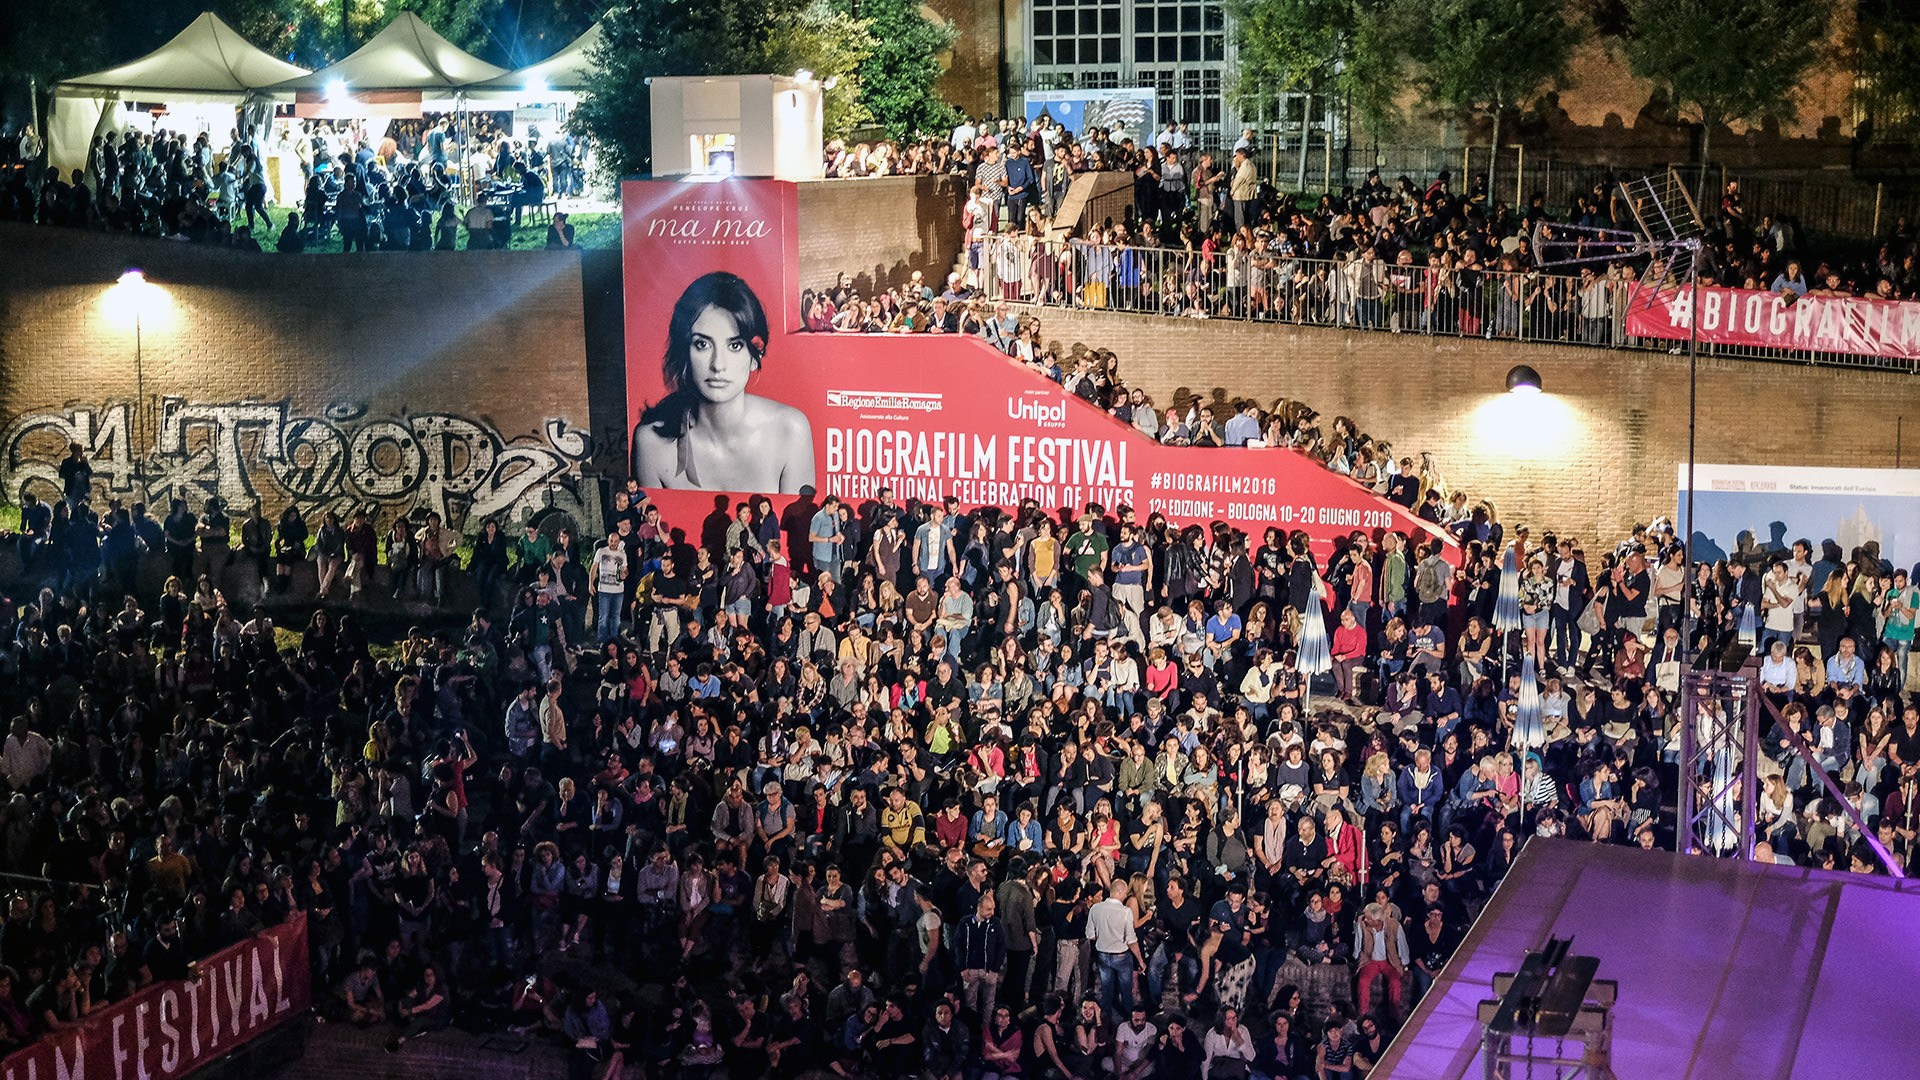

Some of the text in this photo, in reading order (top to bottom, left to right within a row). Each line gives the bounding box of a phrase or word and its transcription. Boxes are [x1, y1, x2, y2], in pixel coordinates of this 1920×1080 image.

[647, 218, 772, 238] ma ma
[1008, 396, 1066, 428] Unipol
[826, 428, 1134, 488] BIOGRAFILM FESTIVAL
[952, 480, 1056, 509] CELEBRATION
[1063, 486, 1082, 511] OF
[1150, 472, 1276, 496] #BIOGRAFILM2016
[1168, 499, 1214, 518] EDIZIONE
[1228, 503, 1277, 522] BOLOGNA
[1318, 508, 1360, 527] GIUGNO
[1363, 510, 1392, 529] 2016
[112, 935, 291, 1080] FESTIVAL
